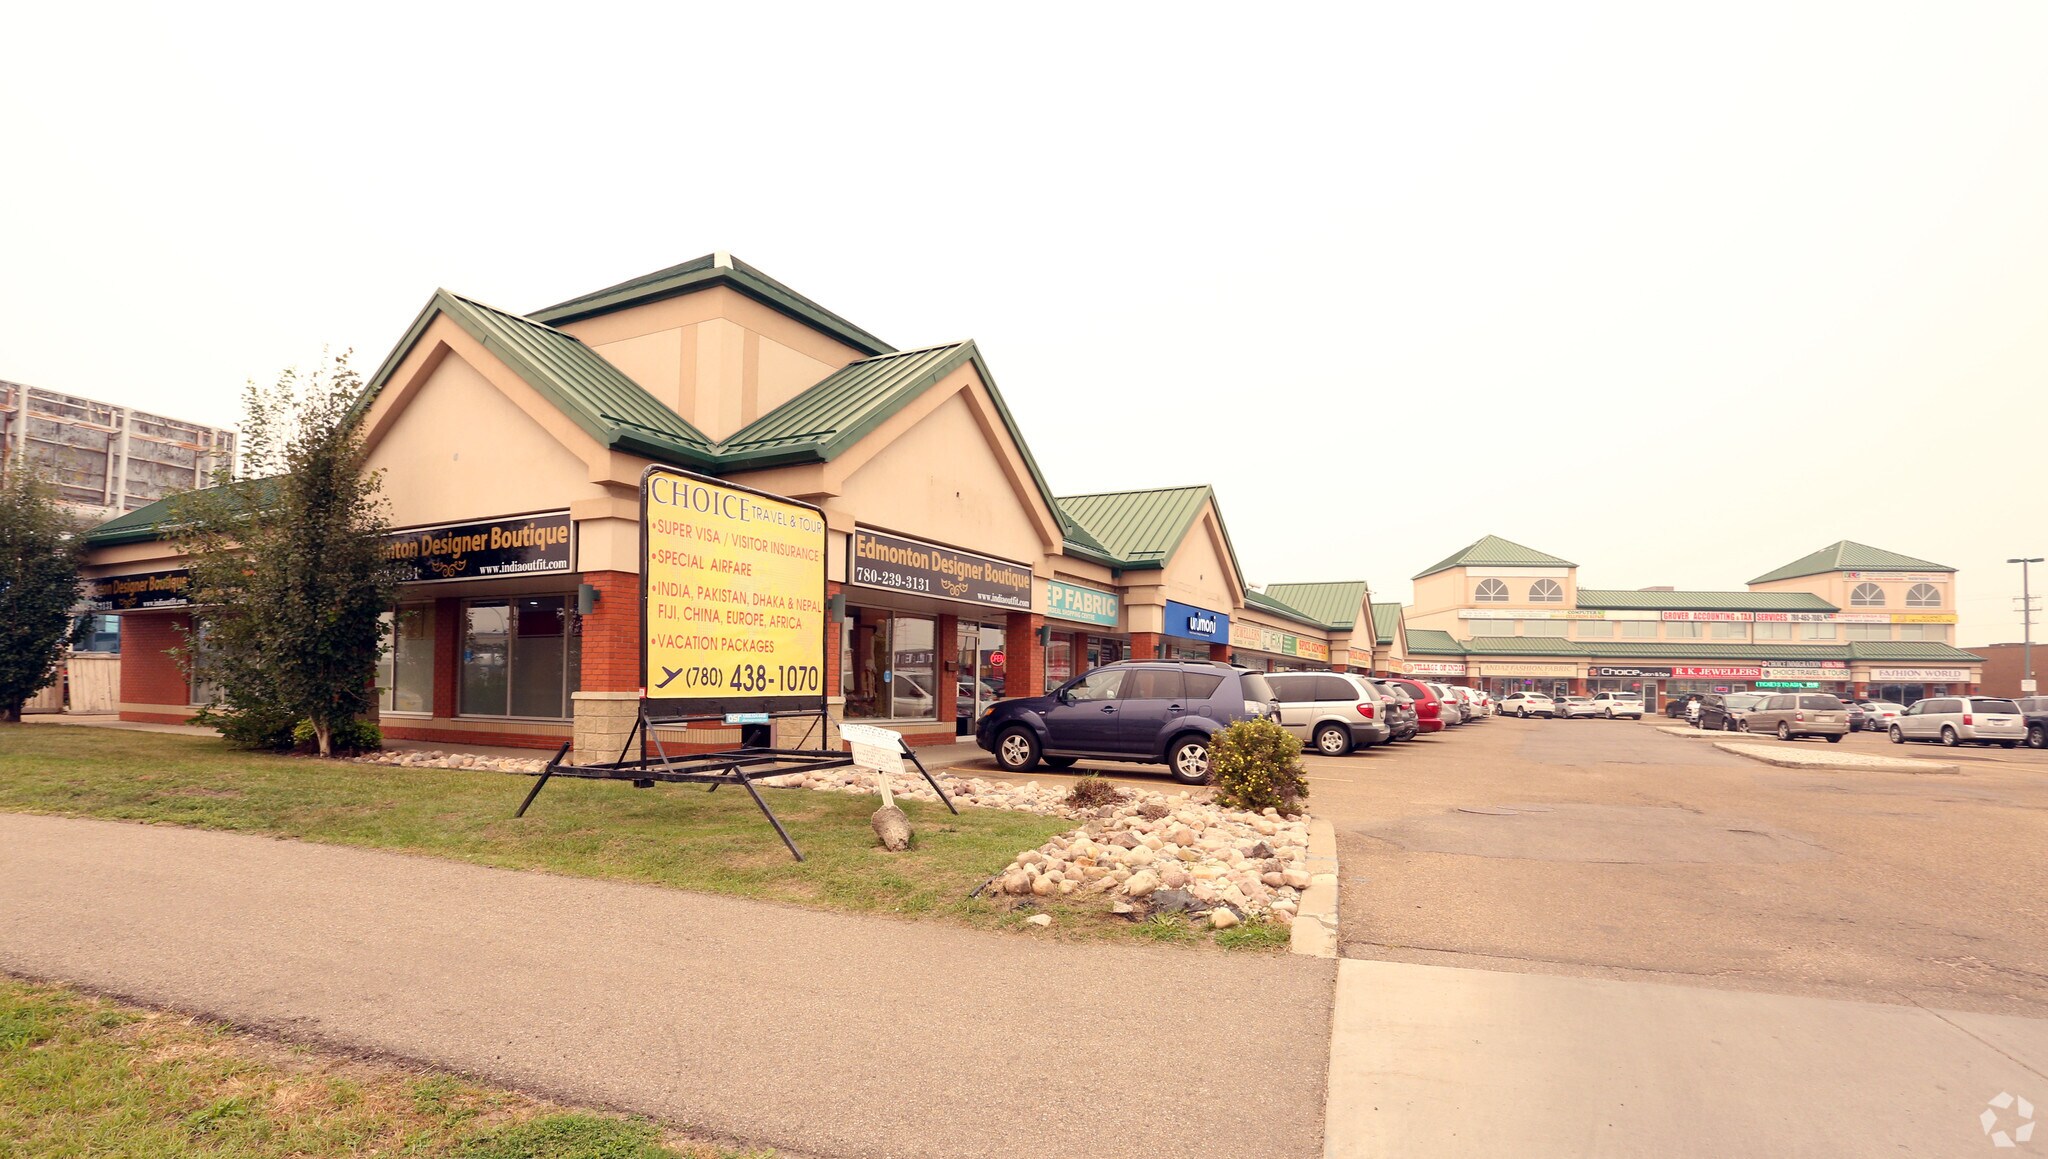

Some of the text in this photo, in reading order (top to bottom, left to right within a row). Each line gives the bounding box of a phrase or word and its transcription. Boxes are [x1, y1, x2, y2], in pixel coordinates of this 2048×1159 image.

[651, 477, 822, 534] CHOICE TRAVEL & TOUR
[422, 532, 488, 559] Designer
[490, 522, 568, 551] Boutique
[658, 520, 692, 539] SUPER
[696, 526, 720, 544] VISA
[731, 533, 768, 553] VISITOR
[770, 542, 819, 562] INSURANCE
[480, 560, 568, 575] www.indiaoutfit.com
[658, 550, 752, 577] SPECIAL AIRFARE
[856, 534, 1030, 592] Edmonton Designer Boutique
[856, 566, 930, 592] 780-239-3131
[658, 582, 822, 613] INDIA, PAKISTAN, DHAKA & NEPAL
[977, 591, 1030, 608] www.indiaoutfit.com
[1065, 588, 1116, 617] FABRIC
[658, 604, 802, 629] FIJI, CHINA, EUROPE, AFRICA
[1663, 612, 1689, 620] GROVER
[1693, 612, 1735, 621] ACCOUNTING
[1740, 613, 1753, 621] TAX
[1756, 613, 1788, 621] SERVICES
[658, 634, 775, 653] VACATION PACKAGES
[686, 664, 818, 692] (780) 438-1070
[1601, 668, 1640, 676] Choice
[1699, 668, 1759, 676] JEWELLERS
